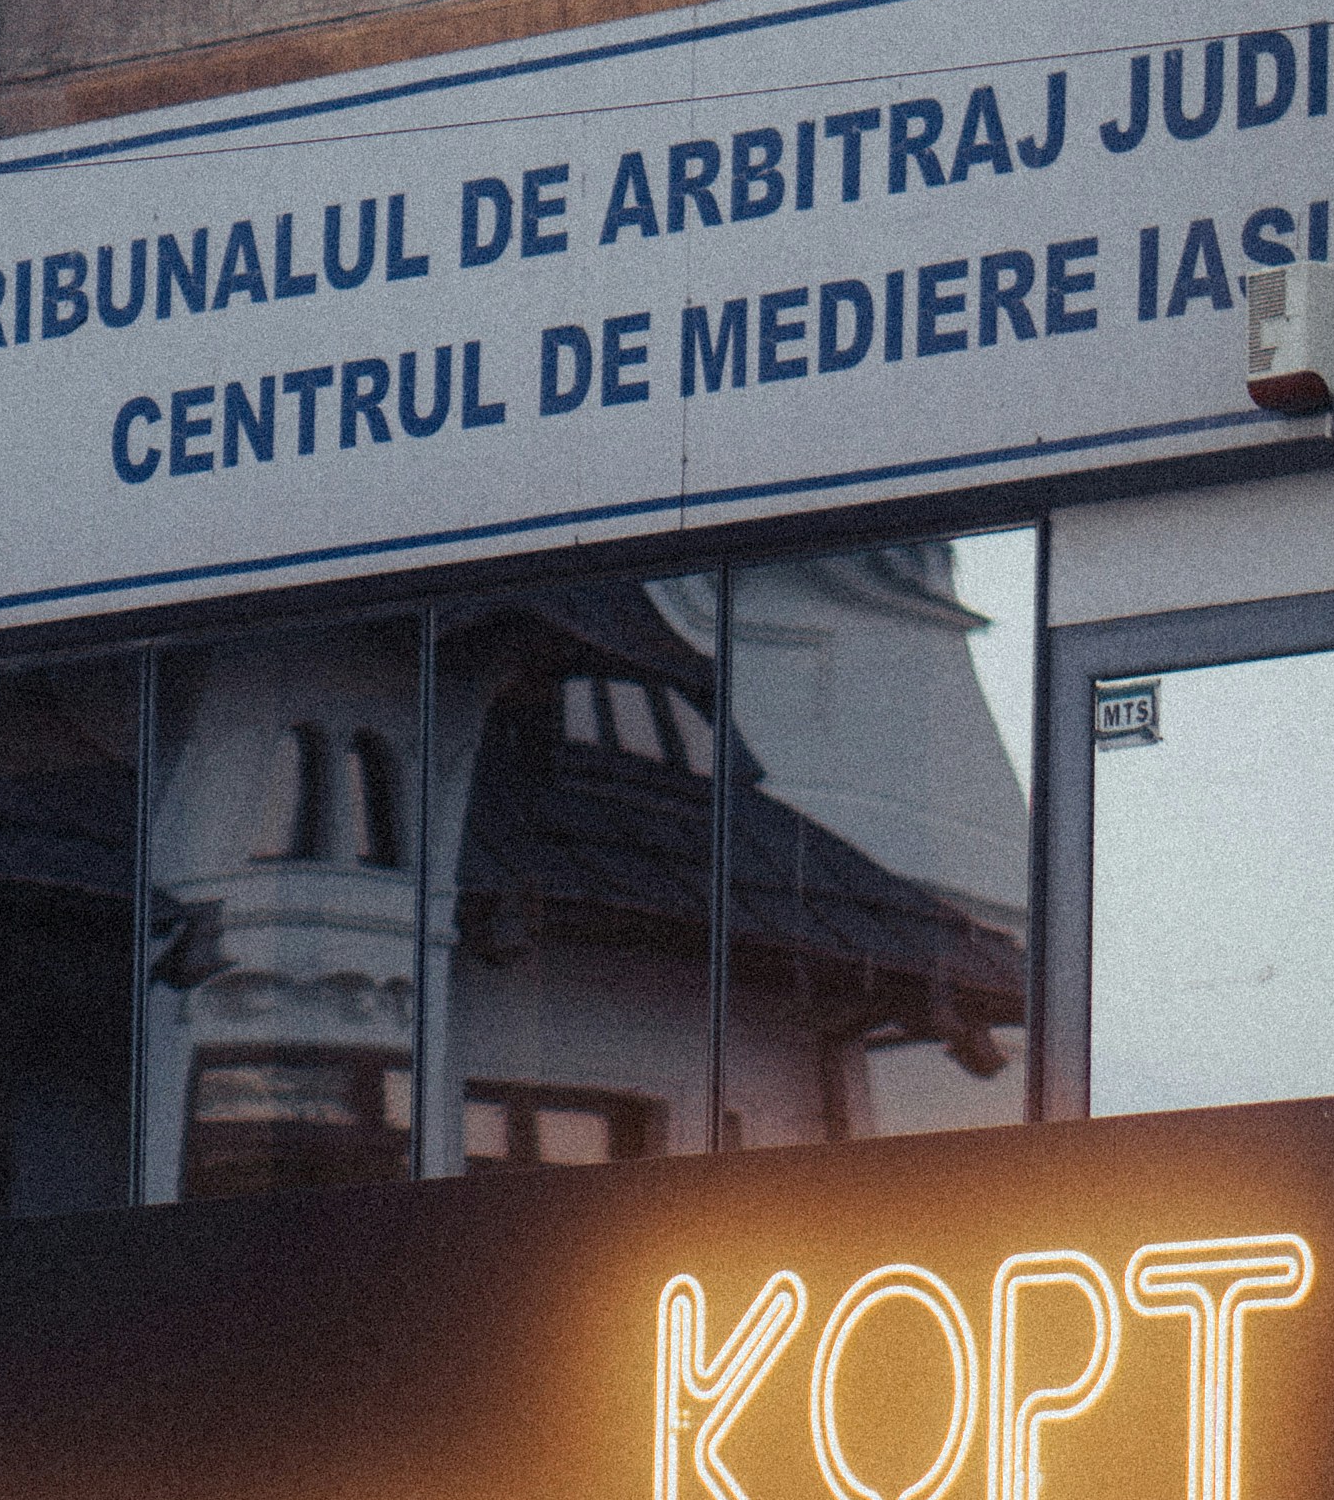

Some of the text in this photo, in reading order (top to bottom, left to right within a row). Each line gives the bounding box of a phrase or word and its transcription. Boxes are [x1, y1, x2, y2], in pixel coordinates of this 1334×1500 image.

[459, 163, 571, 270] DE
[598, 70, 1068, 247] ARBITRAJ
[111, 340, 507, 486] CENTRUL
[538, 311, 652, 418] DE
[679, 236, 1100, 400] MEDIERE
[1102, 698, 1149, 729] MTS
